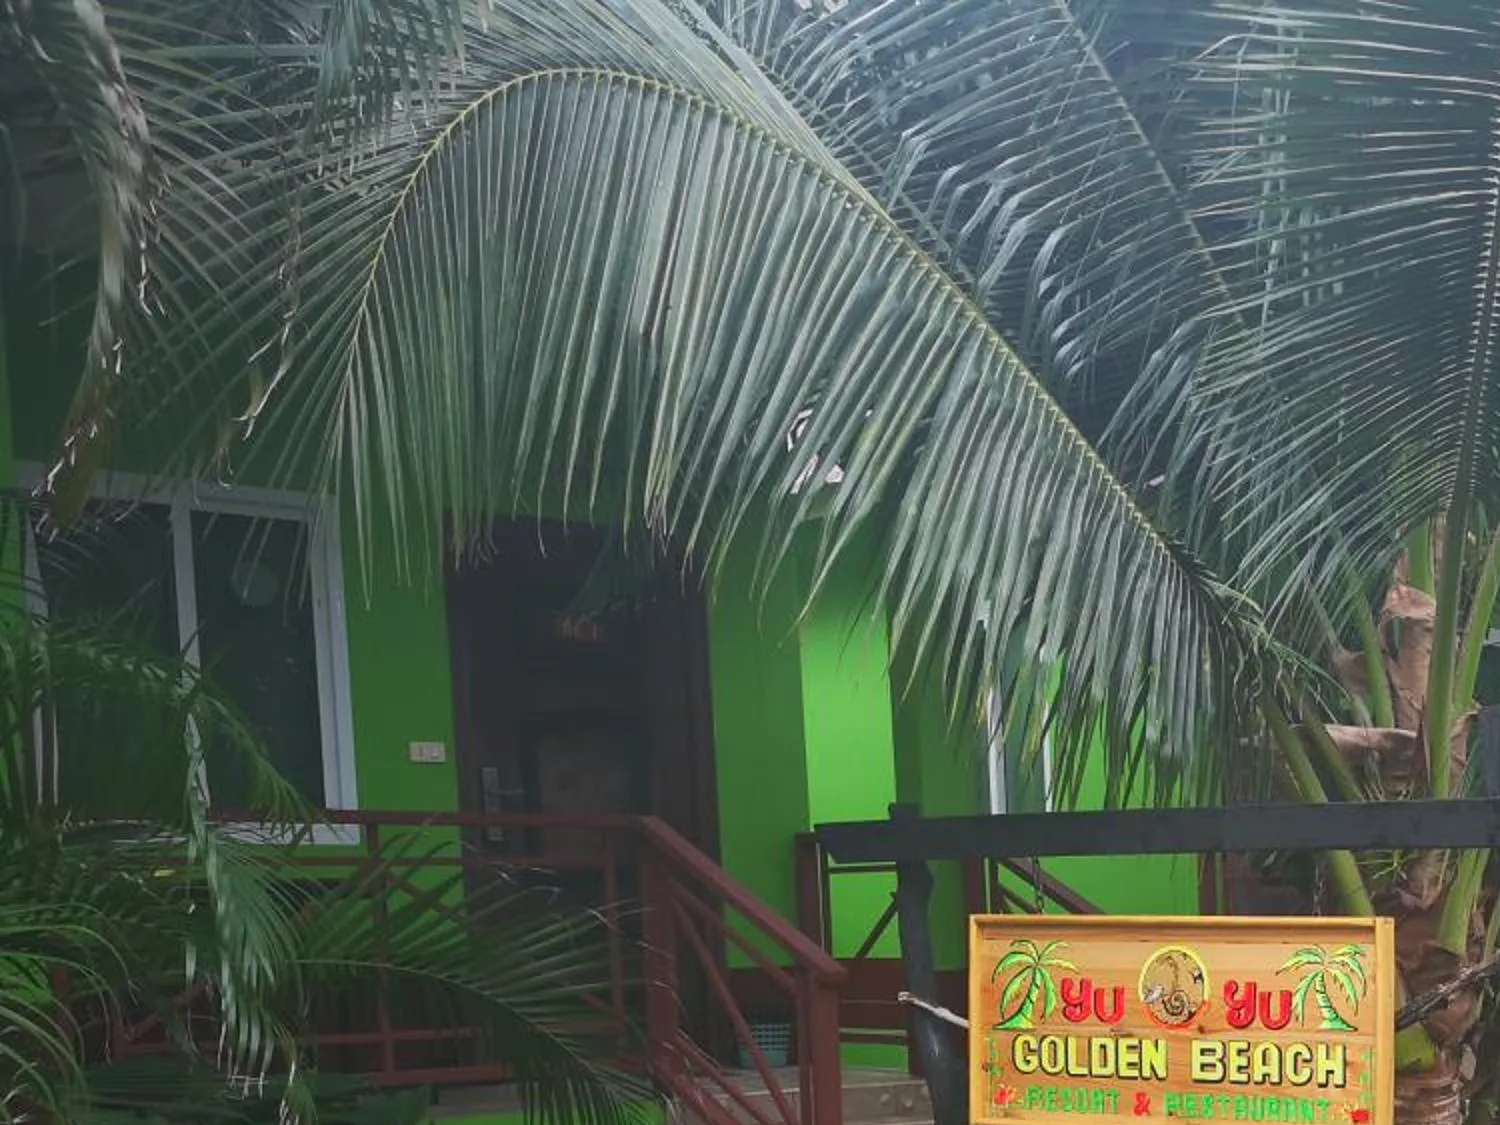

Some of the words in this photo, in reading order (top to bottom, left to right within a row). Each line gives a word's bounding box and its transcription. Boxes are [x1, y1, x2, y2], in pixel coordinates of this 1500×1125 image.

[1013, 1034, 1168, 1080] GOLDEN
[1191, 1039, 1347, 1088] BEACH
[1025, 1086, 1120, 1115] RESORT
[1133, 1092, 1151, 1116] &
[1163, 1092, 1330, 1124] RESTAURANT
